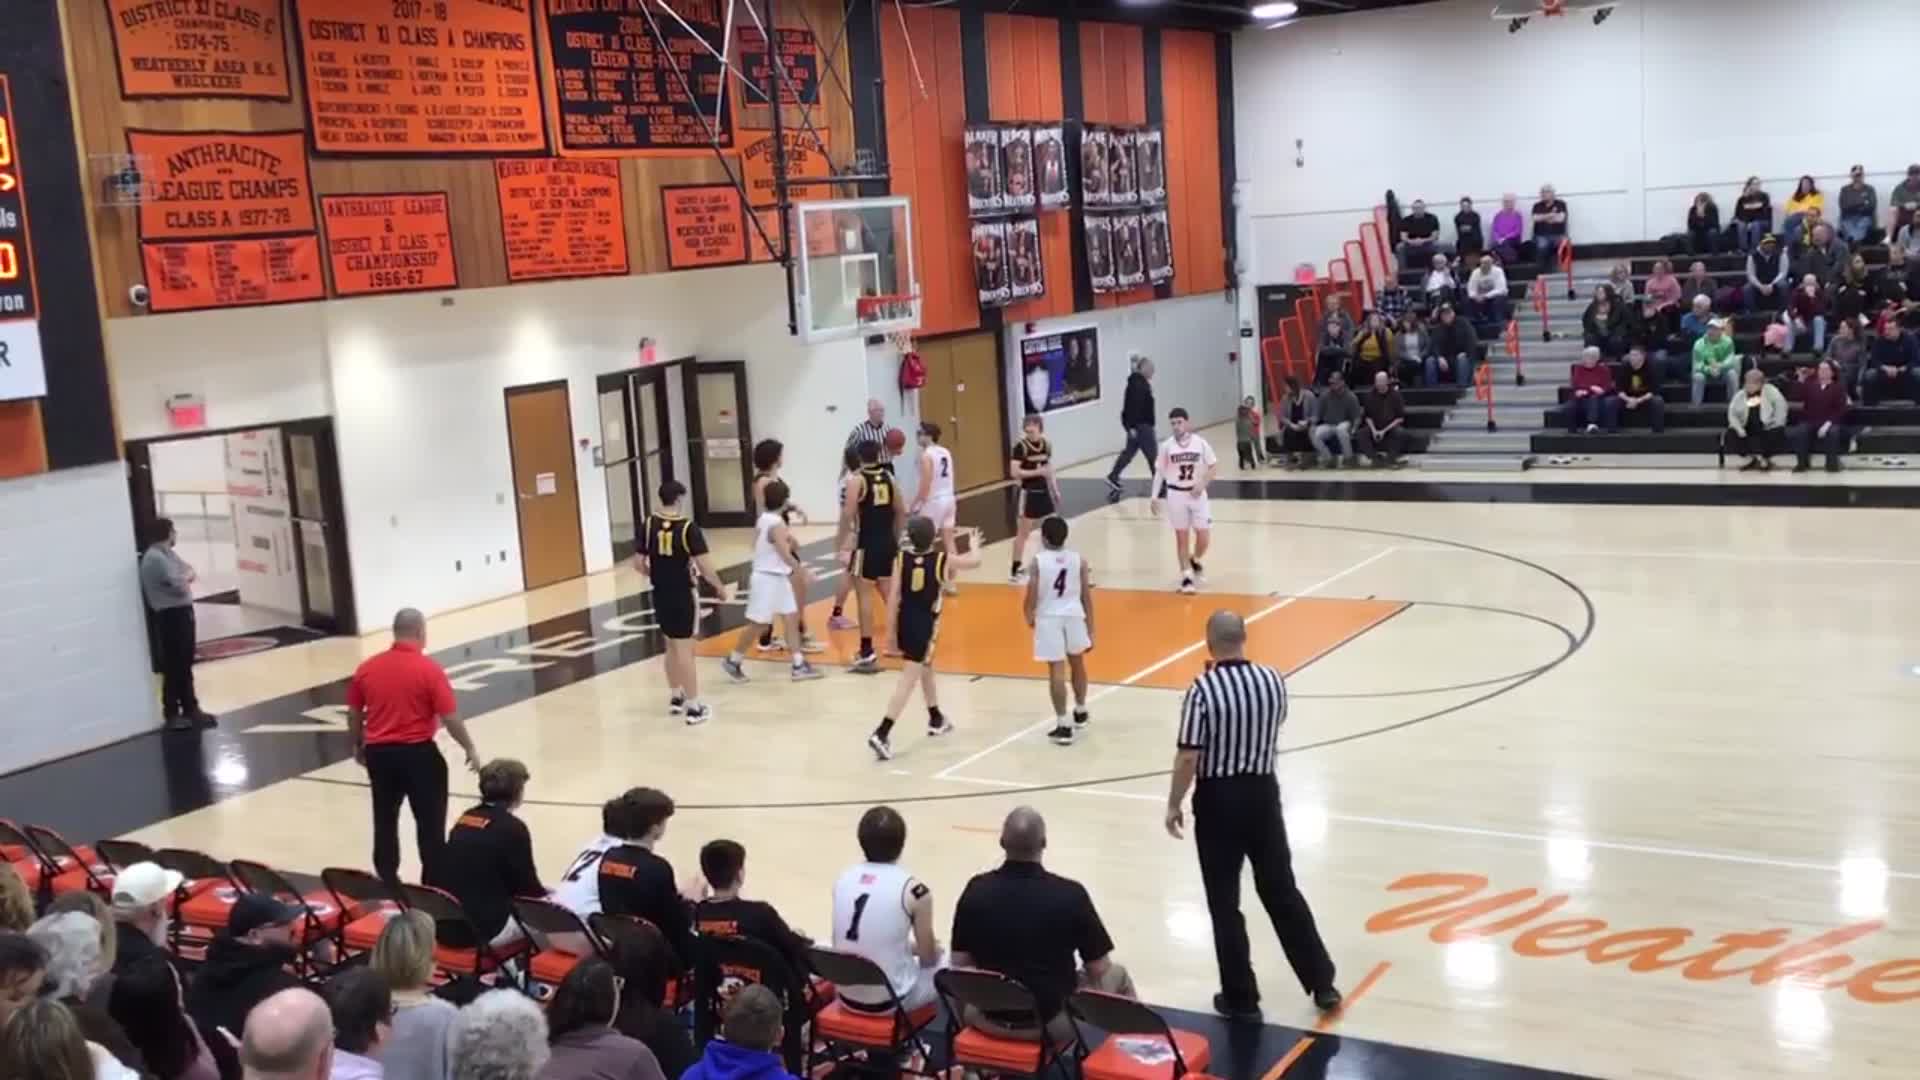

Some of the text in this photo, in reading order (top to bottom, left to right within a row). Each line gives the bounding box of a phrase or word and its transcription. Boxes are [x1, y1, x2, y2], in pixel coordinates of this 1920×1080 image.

[215, 0, 260, 28] CLASS
[309, 18, 366, 41] DISTRICT
[398, 25, 438, 46] CLASS
[463, 29, 525, 50] CHAMPIONS
[131, 57, 207, 72] WEATHERLY
[213, 60, 248, 75] AREA
[173, 74, 242, 89] WRECKERS
[166, 143, 281, 178] ANTHRACITE
[229, 178, 299, 199] CHAMPS
[166, 210, 216, 228] CLASS
[222, 210, 232, 226] A
[941, 457, 949, 478] 2
[657, 529, 673, 556] 11
[1053, 569, 1067, 598] 4
[845, 893, 870, 942] 1
